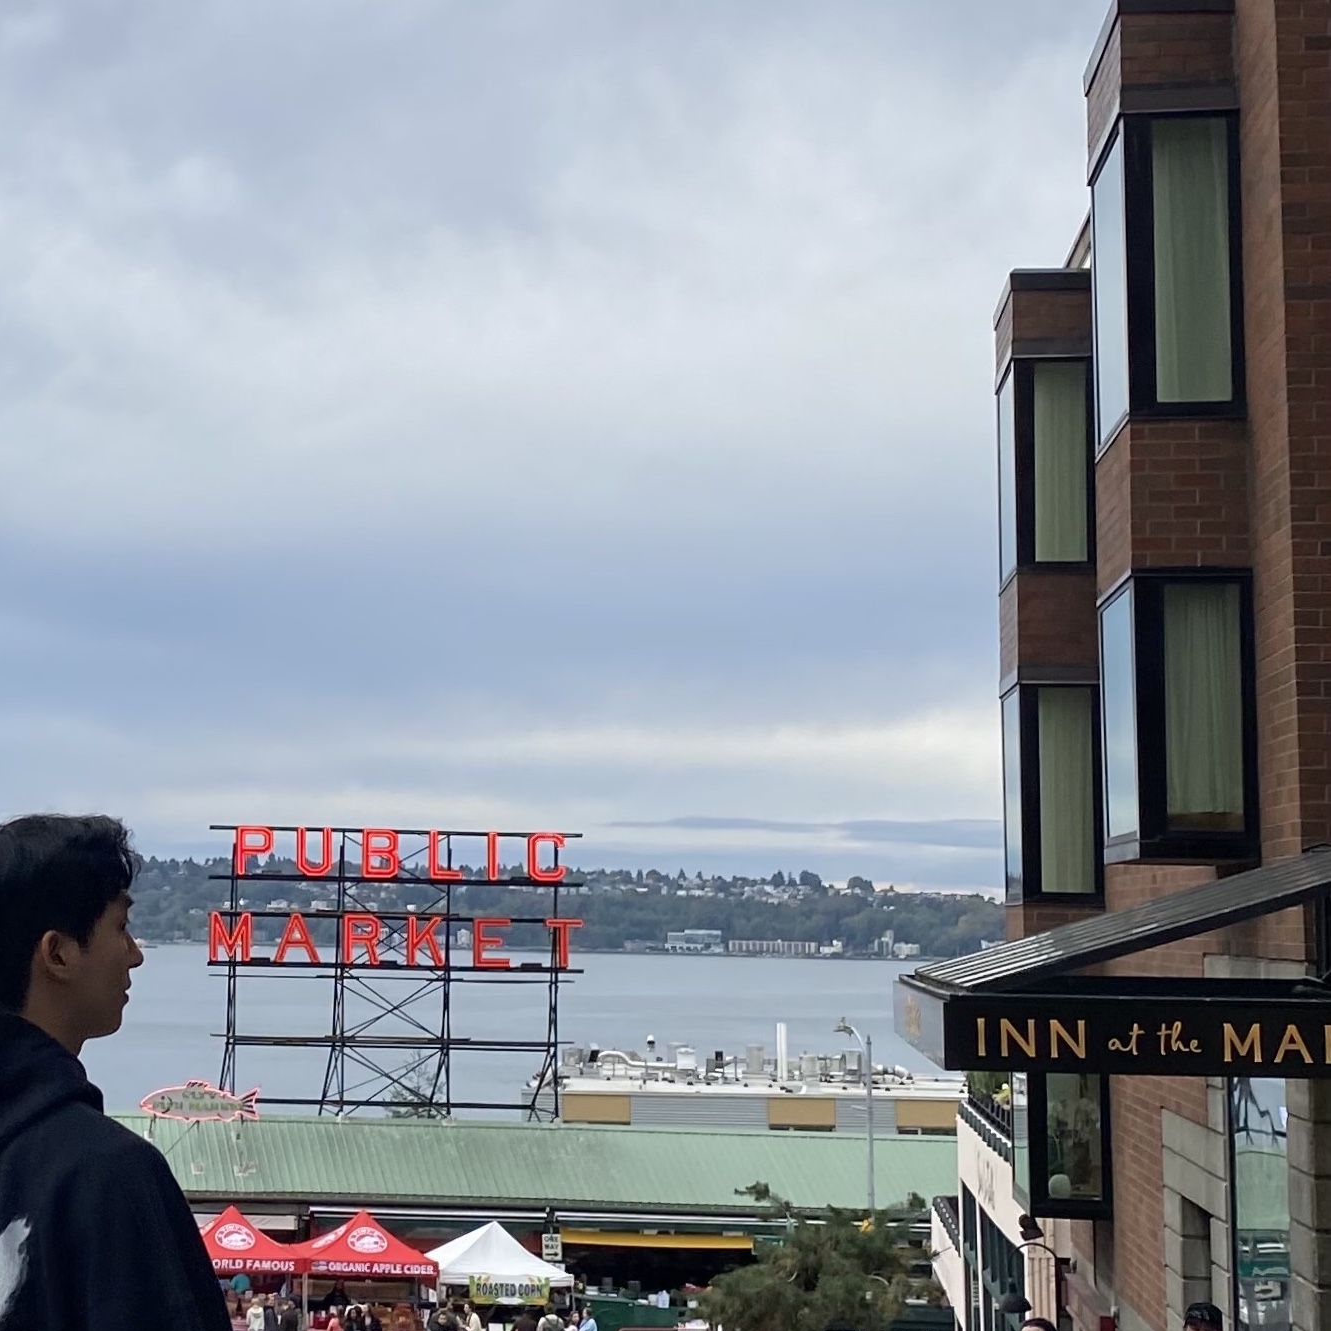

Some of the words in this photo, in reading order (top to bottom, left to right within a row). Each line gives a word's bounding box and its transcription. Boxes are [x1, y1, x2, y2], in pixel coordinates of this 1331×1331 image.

[235, 825, 567, 882] PUBLIC
[208, 911, 584, 970] MARKET
[976, 1017, 1087, 1060] INN
[1107, 1022, 1145, 1056] at
[1156, 1020, 1203, 1056] the
[213, 1259, 244, 1270] ORLD
[245, 1259, 295, 1272] FAMOUS
[328, 1261, 371, 1272] ORGANIC
[372, 1262, 402, 1274] APPLE
[404, 1264, 434, 1275] CIDER
[475, 1282, 517, 1297] ROASTED
[518, 1283, 543, 1297] CORN
